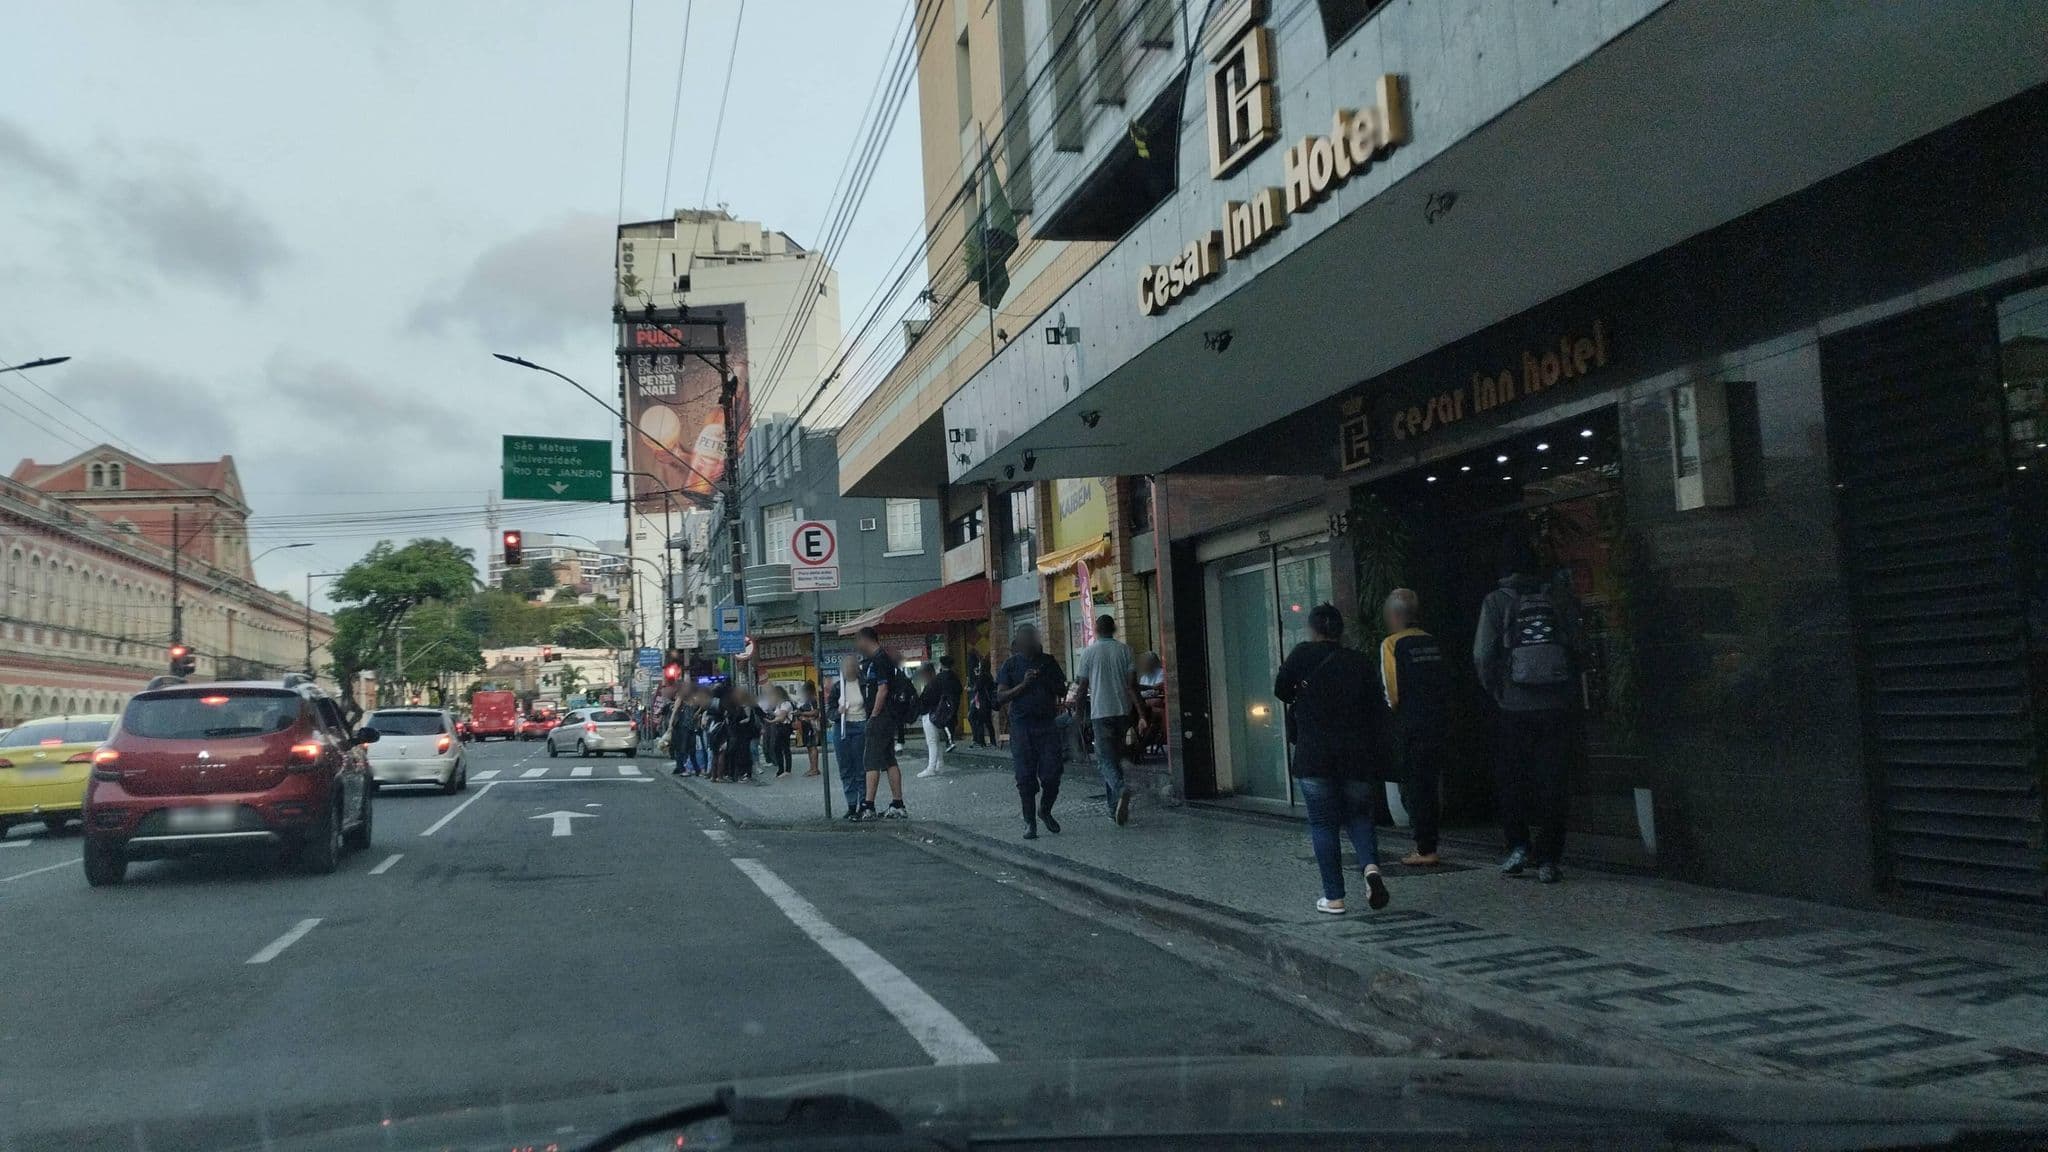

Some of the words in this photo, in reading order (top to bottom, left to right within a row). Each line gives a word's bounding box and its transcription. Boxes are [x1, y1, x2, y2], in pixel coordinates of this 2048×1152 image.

[1137, 229, 1222, 316] Cesar
[1223, 187, 1284, 260] Inn
[1285, 73, 1404, 213] Hotel
[638, 374, 676, 385] PETRA
[639, 385, 677, 397] MALTE
[513, 441, 534, 450] São
[539, 443, 578, 453] Mateus
[700, 437, 726, 452] PETR
[513, 454, 583, 465] Universidade
[512, 467, 532, 476] RIO
[536, 468, 551, 476] DE
[557, 469, 603, 478] JANEIRO
[805, 530, 822, 557] E
